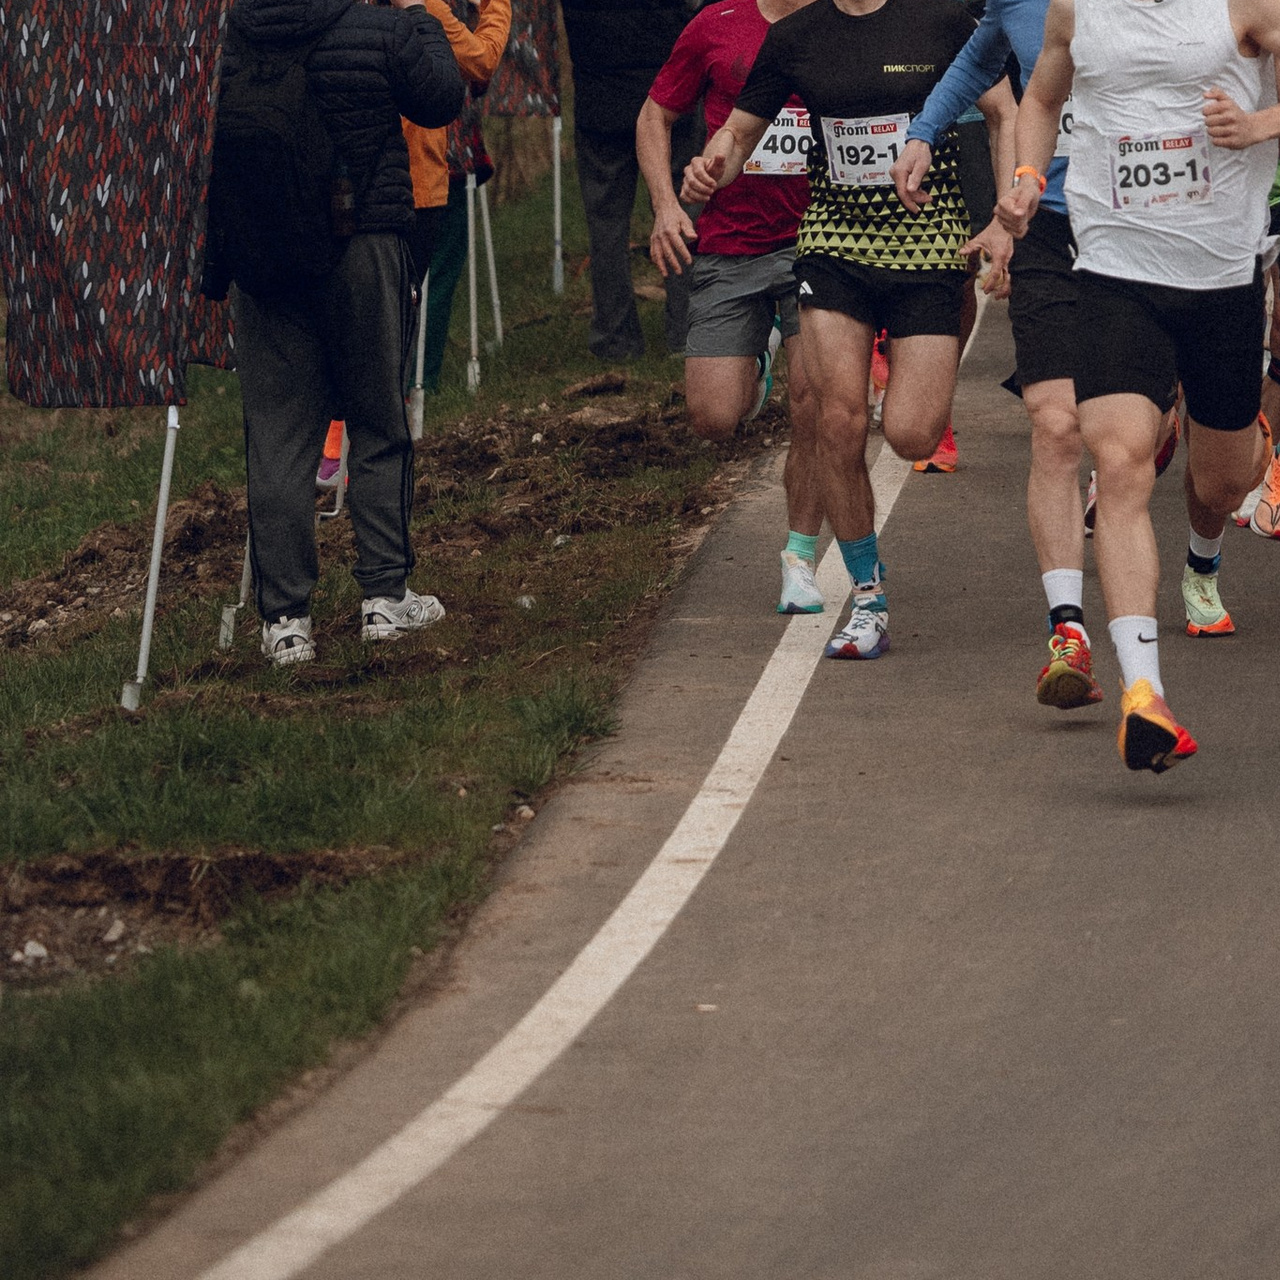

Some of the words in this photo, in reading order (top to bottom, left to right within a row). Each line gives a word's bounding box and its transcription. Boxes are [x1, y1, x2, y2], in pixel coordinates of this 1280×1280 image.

[883, 64, 936, 73] ПИКСПОРТ
[772, 117, 795, 128] om
[799, 119, 811, 127] REL
[833, 125, 869, 138] grom
[872, 124, 896, 133] RELAY
[762, 134, 814, 155] 400
[836, 142, 899, 166] 192-1
[1118, 139, 1161, 157] grom
[1164, 138, 1191, 148] RELAY
[1117, 158, 1199, 189] 203-1
